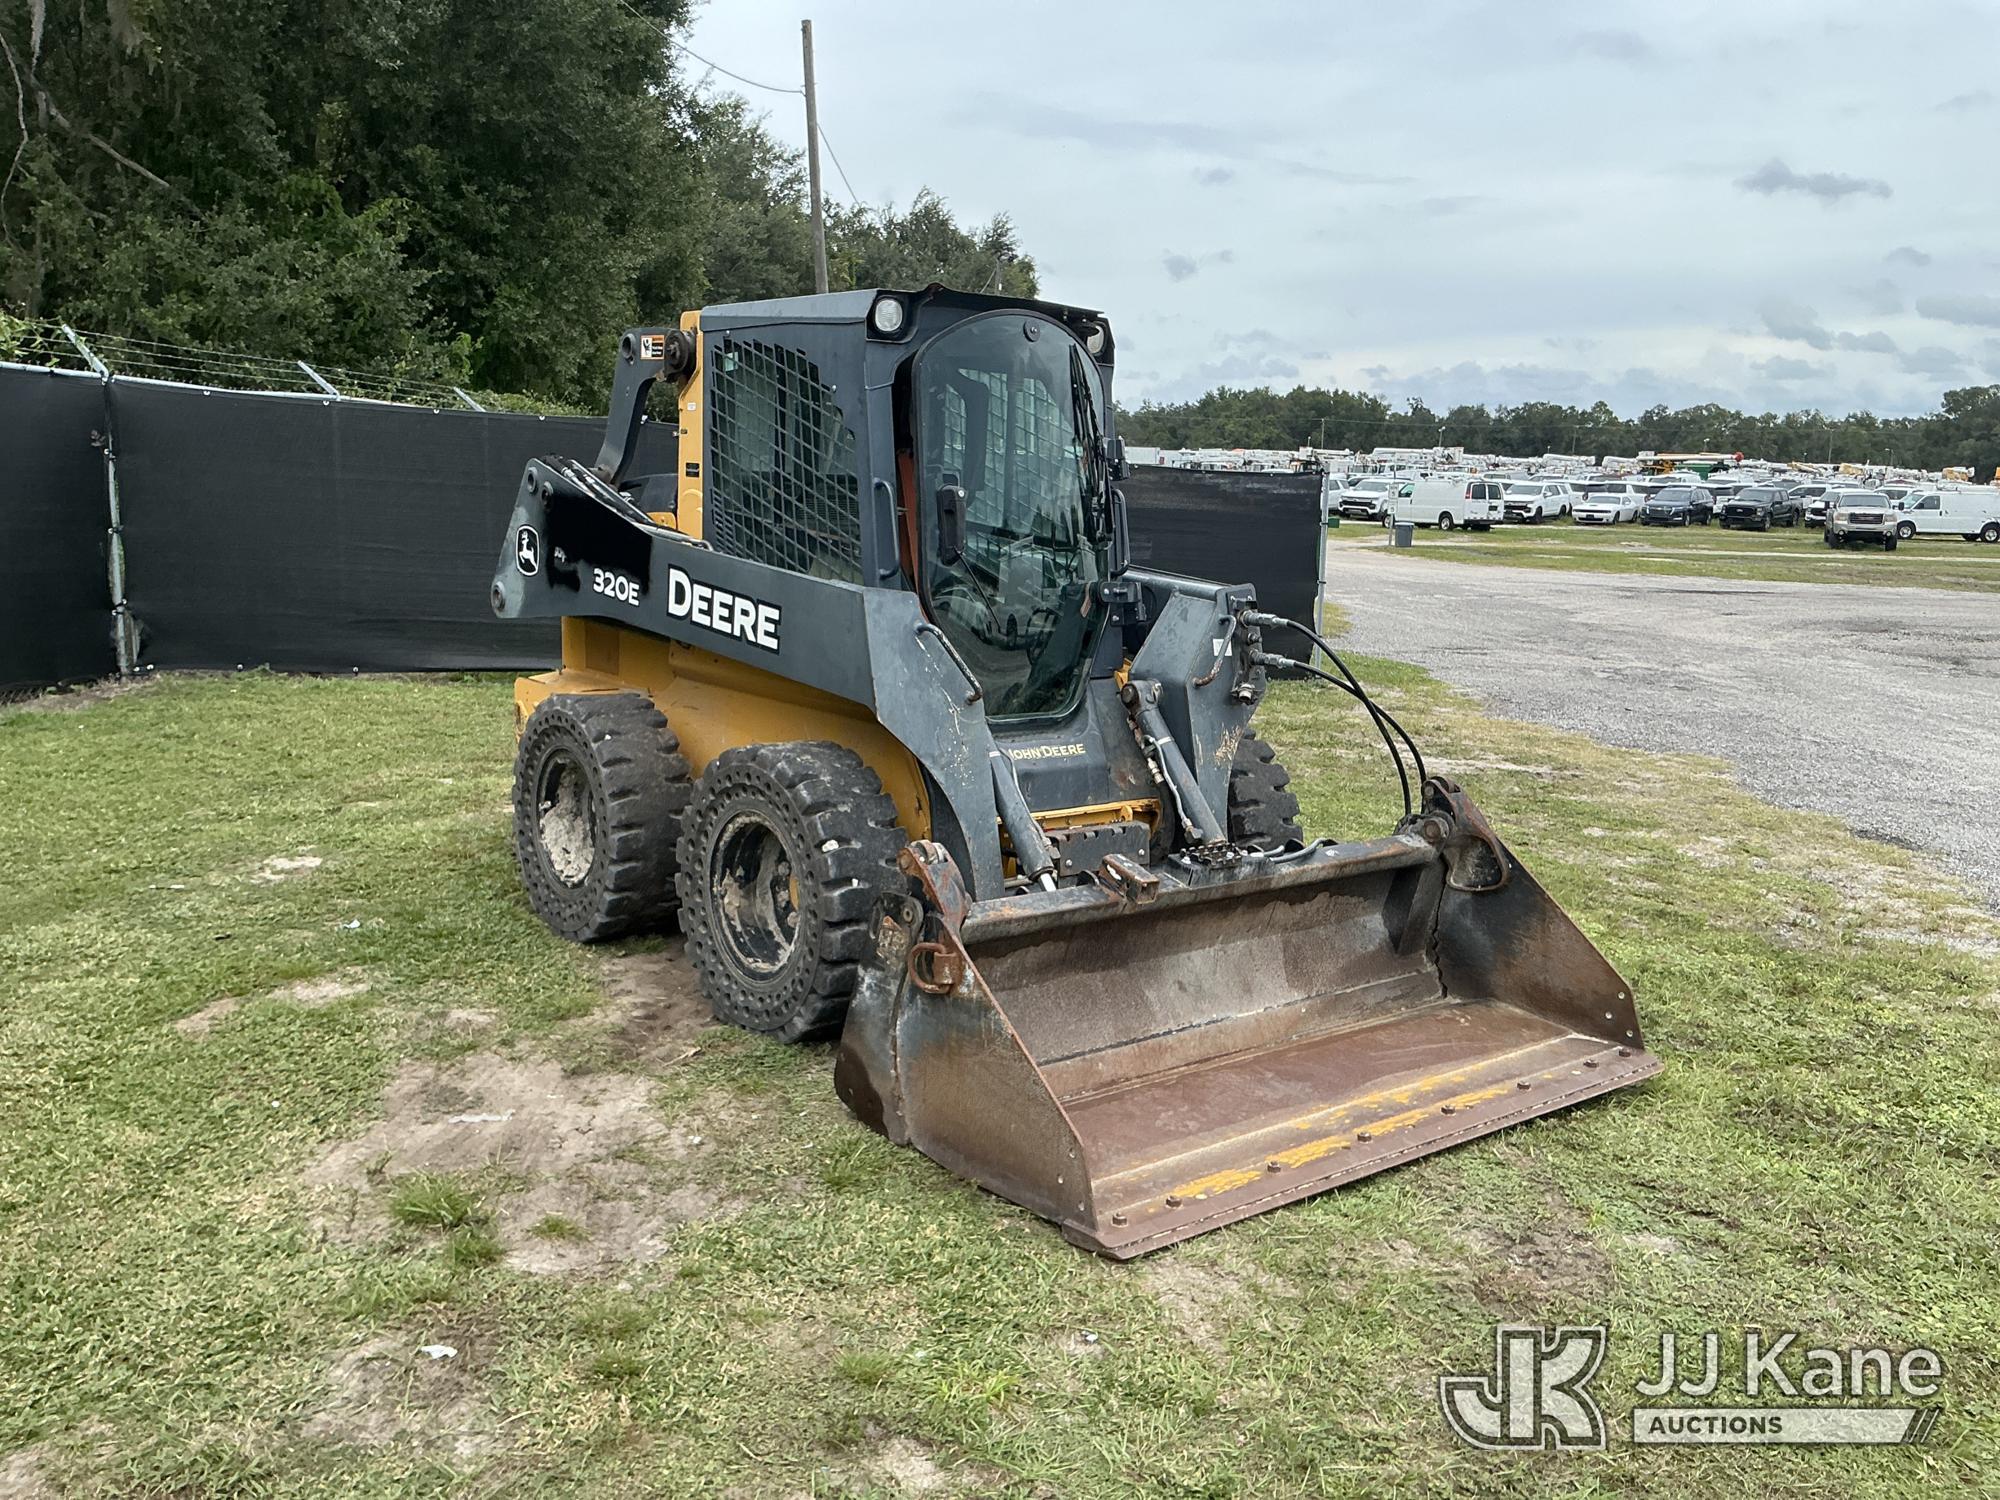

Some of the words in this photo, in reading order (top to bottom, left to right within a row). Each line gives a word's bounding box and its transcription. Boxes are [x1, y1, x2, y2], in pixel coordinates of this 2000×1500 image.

[593, 567, 640, 607] 320E
[667, 567, 781, 651] DEERE
[1008, 747, 1040, 760] JOHN
[1040, 743, 1086, 758] DEERE
